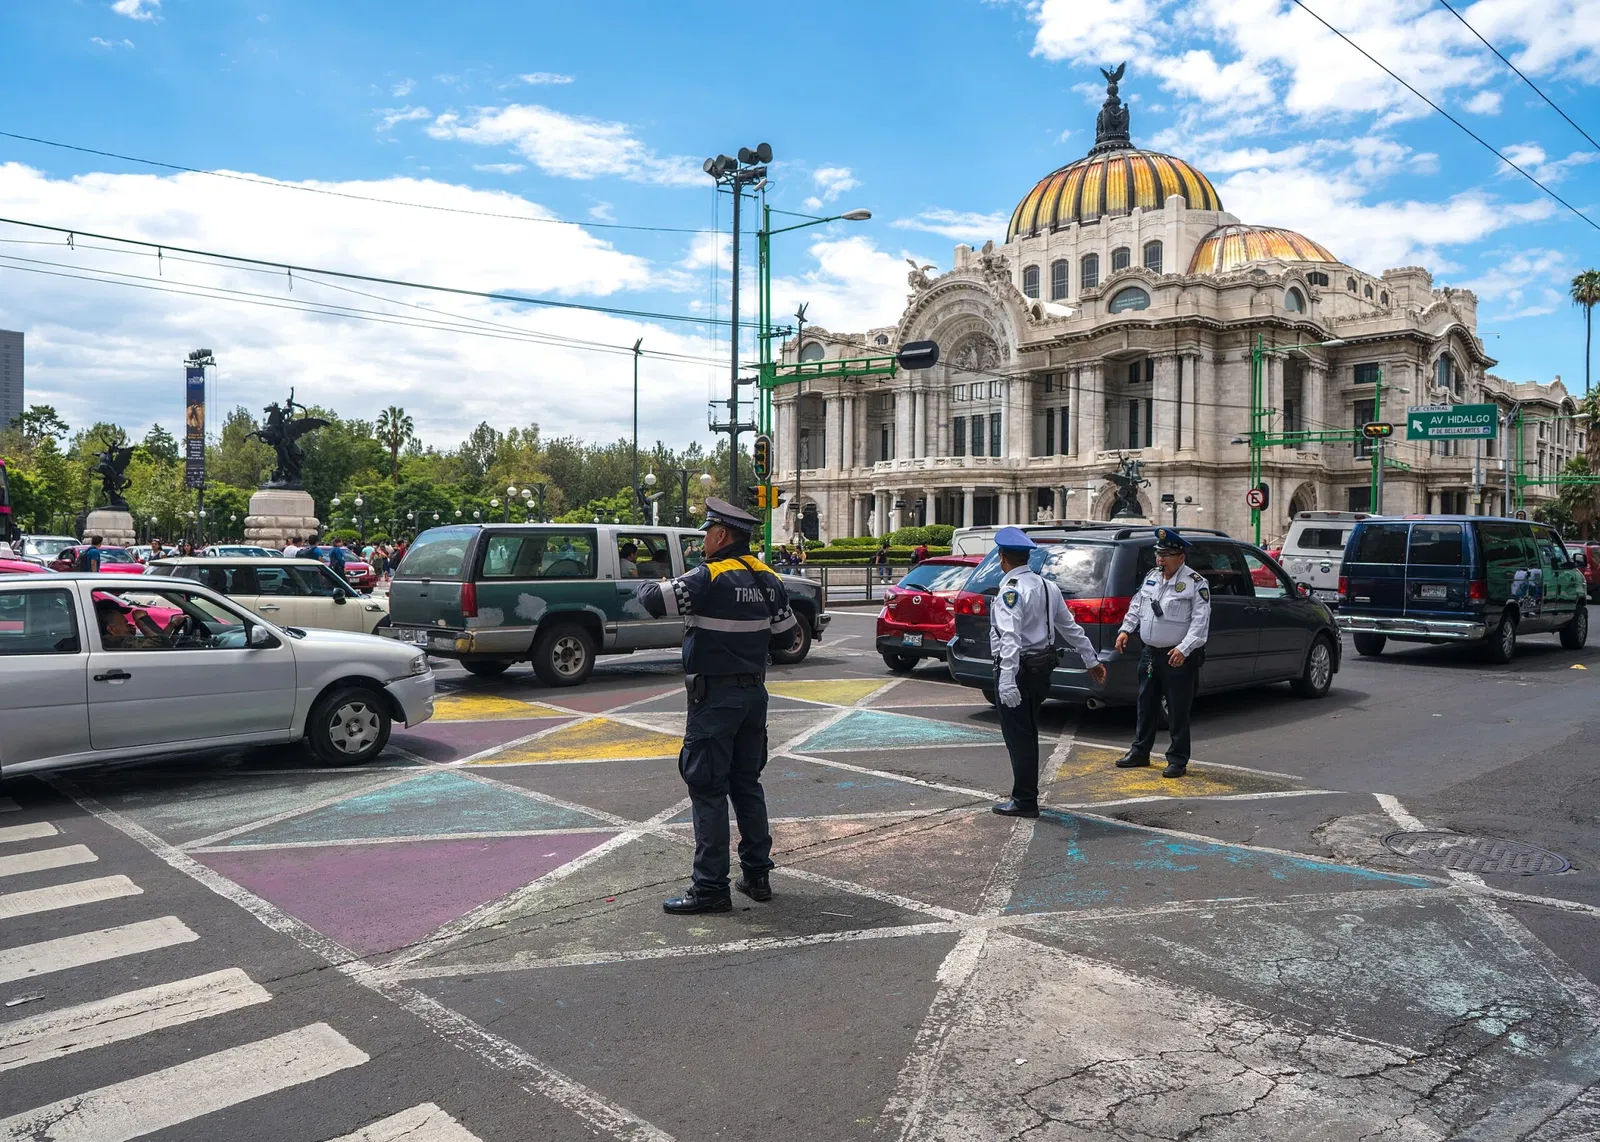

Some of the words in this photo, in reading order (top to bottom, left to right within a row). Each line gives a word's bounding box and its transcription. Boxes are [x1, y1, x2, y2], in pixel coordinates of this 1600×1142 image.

[1430, 416, 1443, 424] AV
[1447, 414, 1490, 424] HIDALGO
[735, 587, 776, 602] TRANSO
